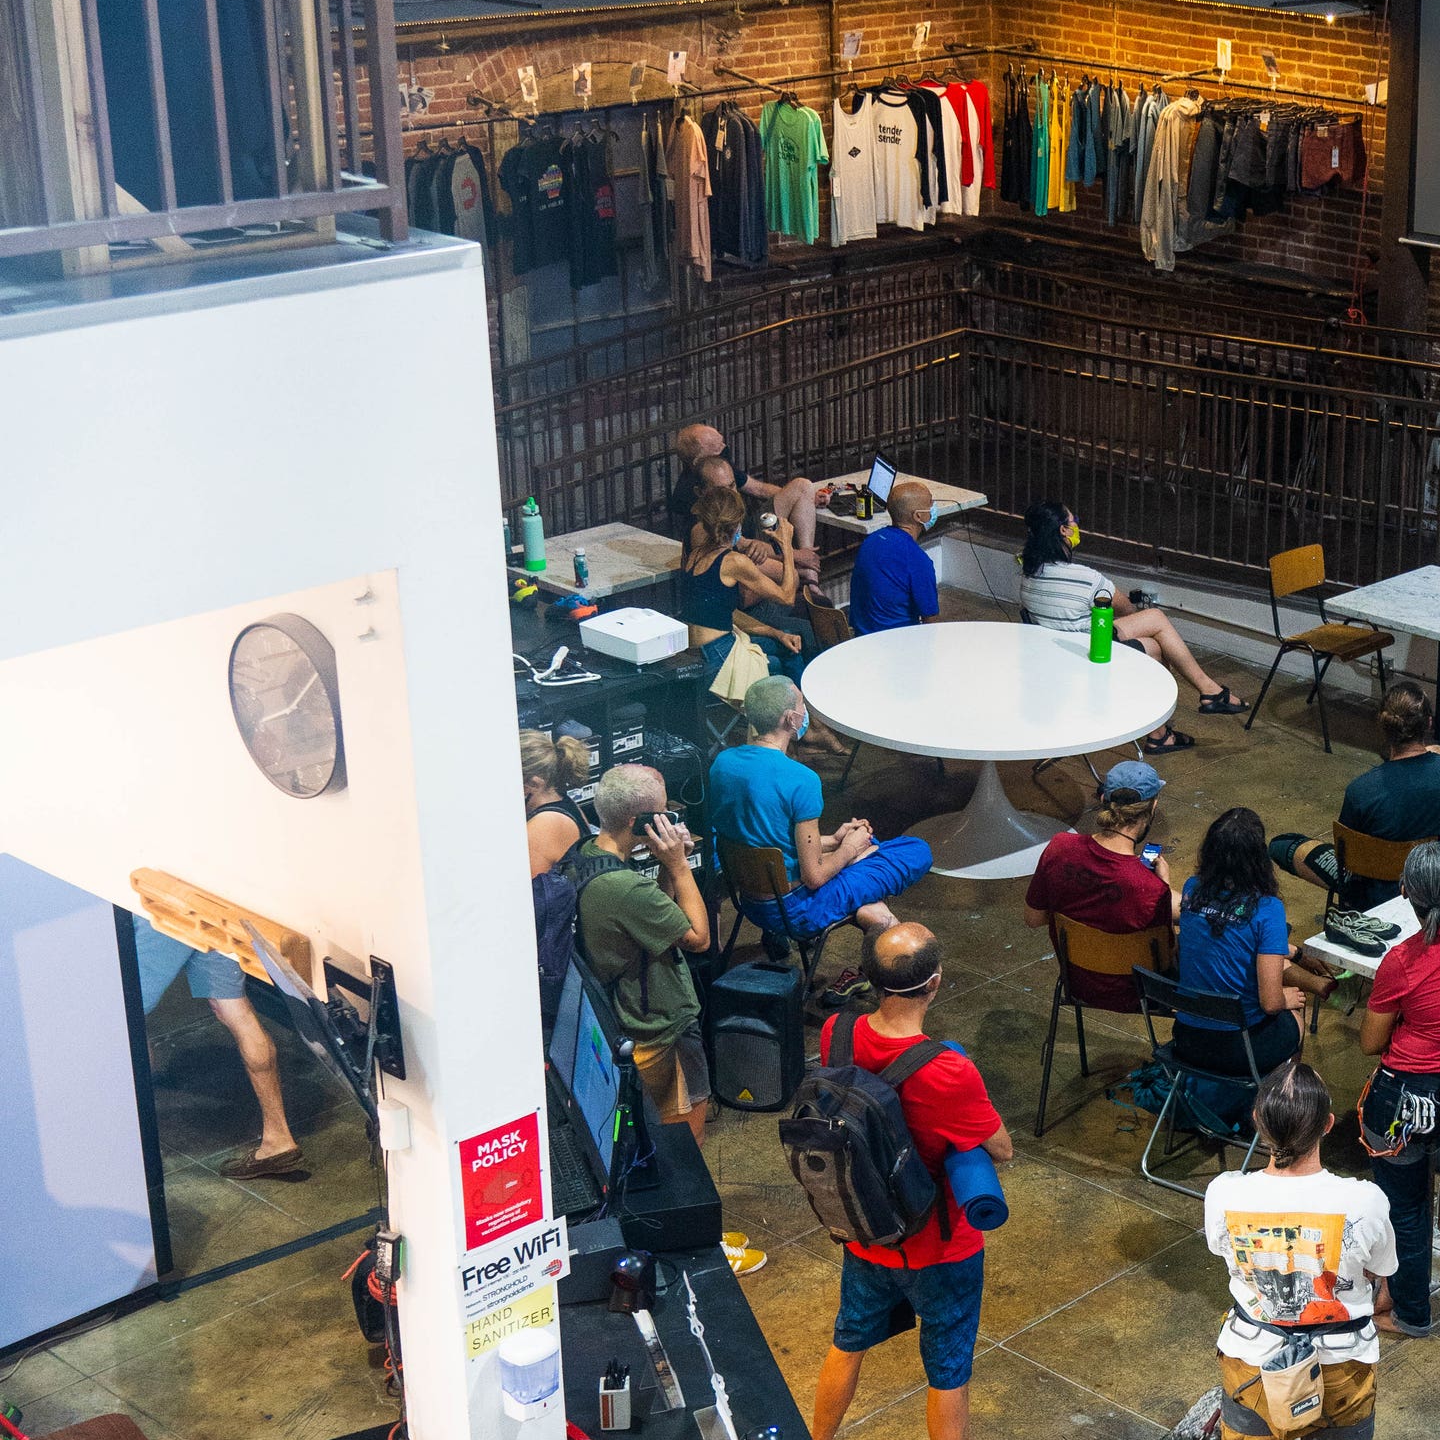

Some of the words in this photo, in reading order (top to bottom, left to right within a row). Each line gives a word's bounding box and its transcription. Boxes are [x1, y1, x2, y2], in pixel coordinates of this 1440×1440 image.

[878, 123, 902, 135] tender
[878, 134, 902, 146] sender.
[471, 1139, 528, 1172] POLICY
[477, 1129, 521, 1157] MASK
[462, 1256, 511, 1291] Free
[513, 1227, 561, 1265] WiFi
[482, 1274, 528, 1301] STRONGHOLD
[471, 1306, 512, 1333] HAND
[472, 1306, 550, 1350] SANITIZER
